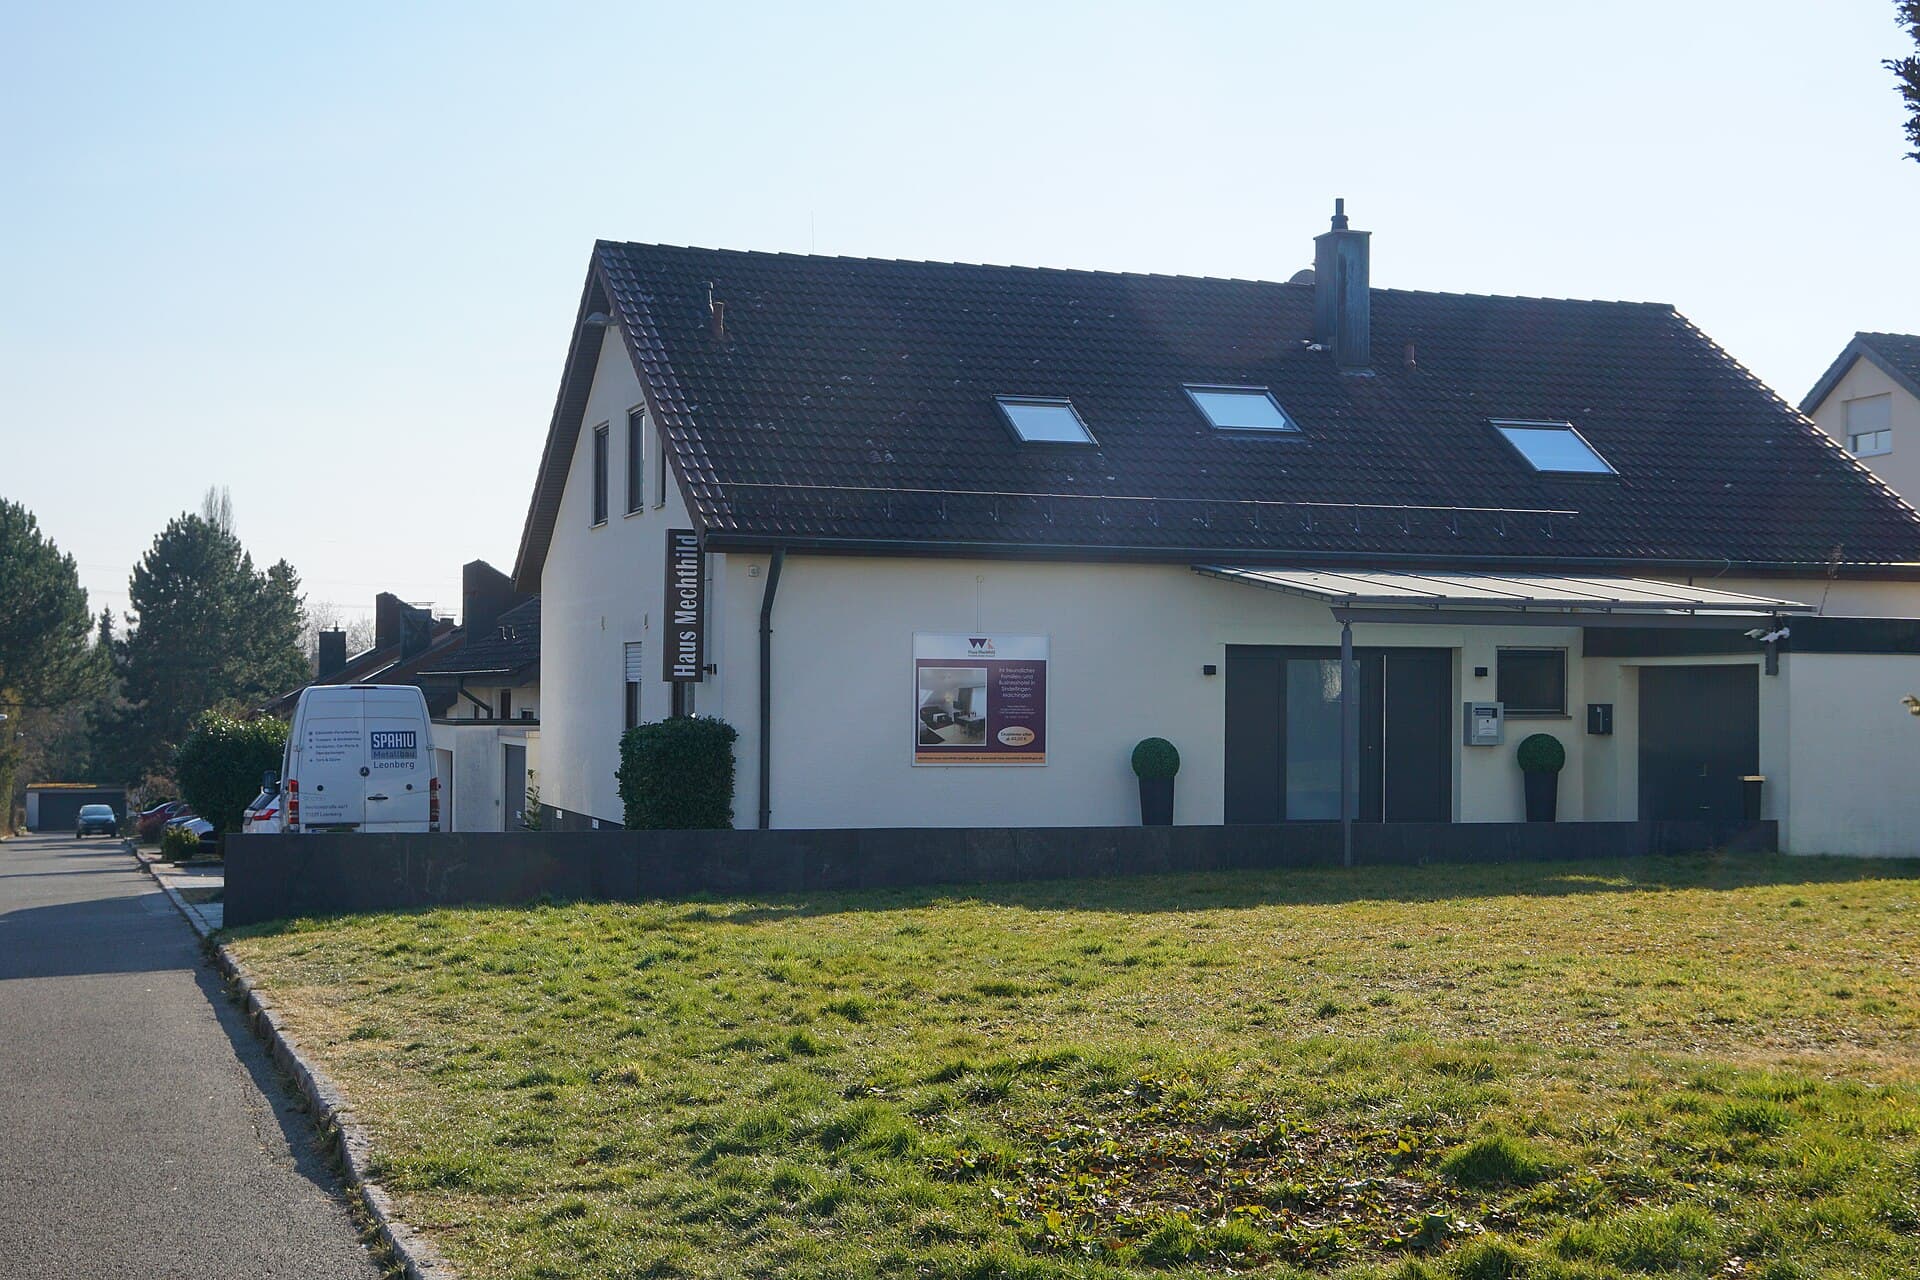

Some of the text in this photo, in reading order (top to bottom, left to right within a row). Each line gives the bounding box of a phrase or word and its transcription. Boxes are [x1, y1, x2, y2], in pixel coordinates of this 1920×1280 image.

[673, 535, 698, 677] Haus Mechthild
[373, 733, 414, 748] SPAHIU
[373, 750, 415, 758] Metallbau
[373, 761, 415, 769] Leonberg
